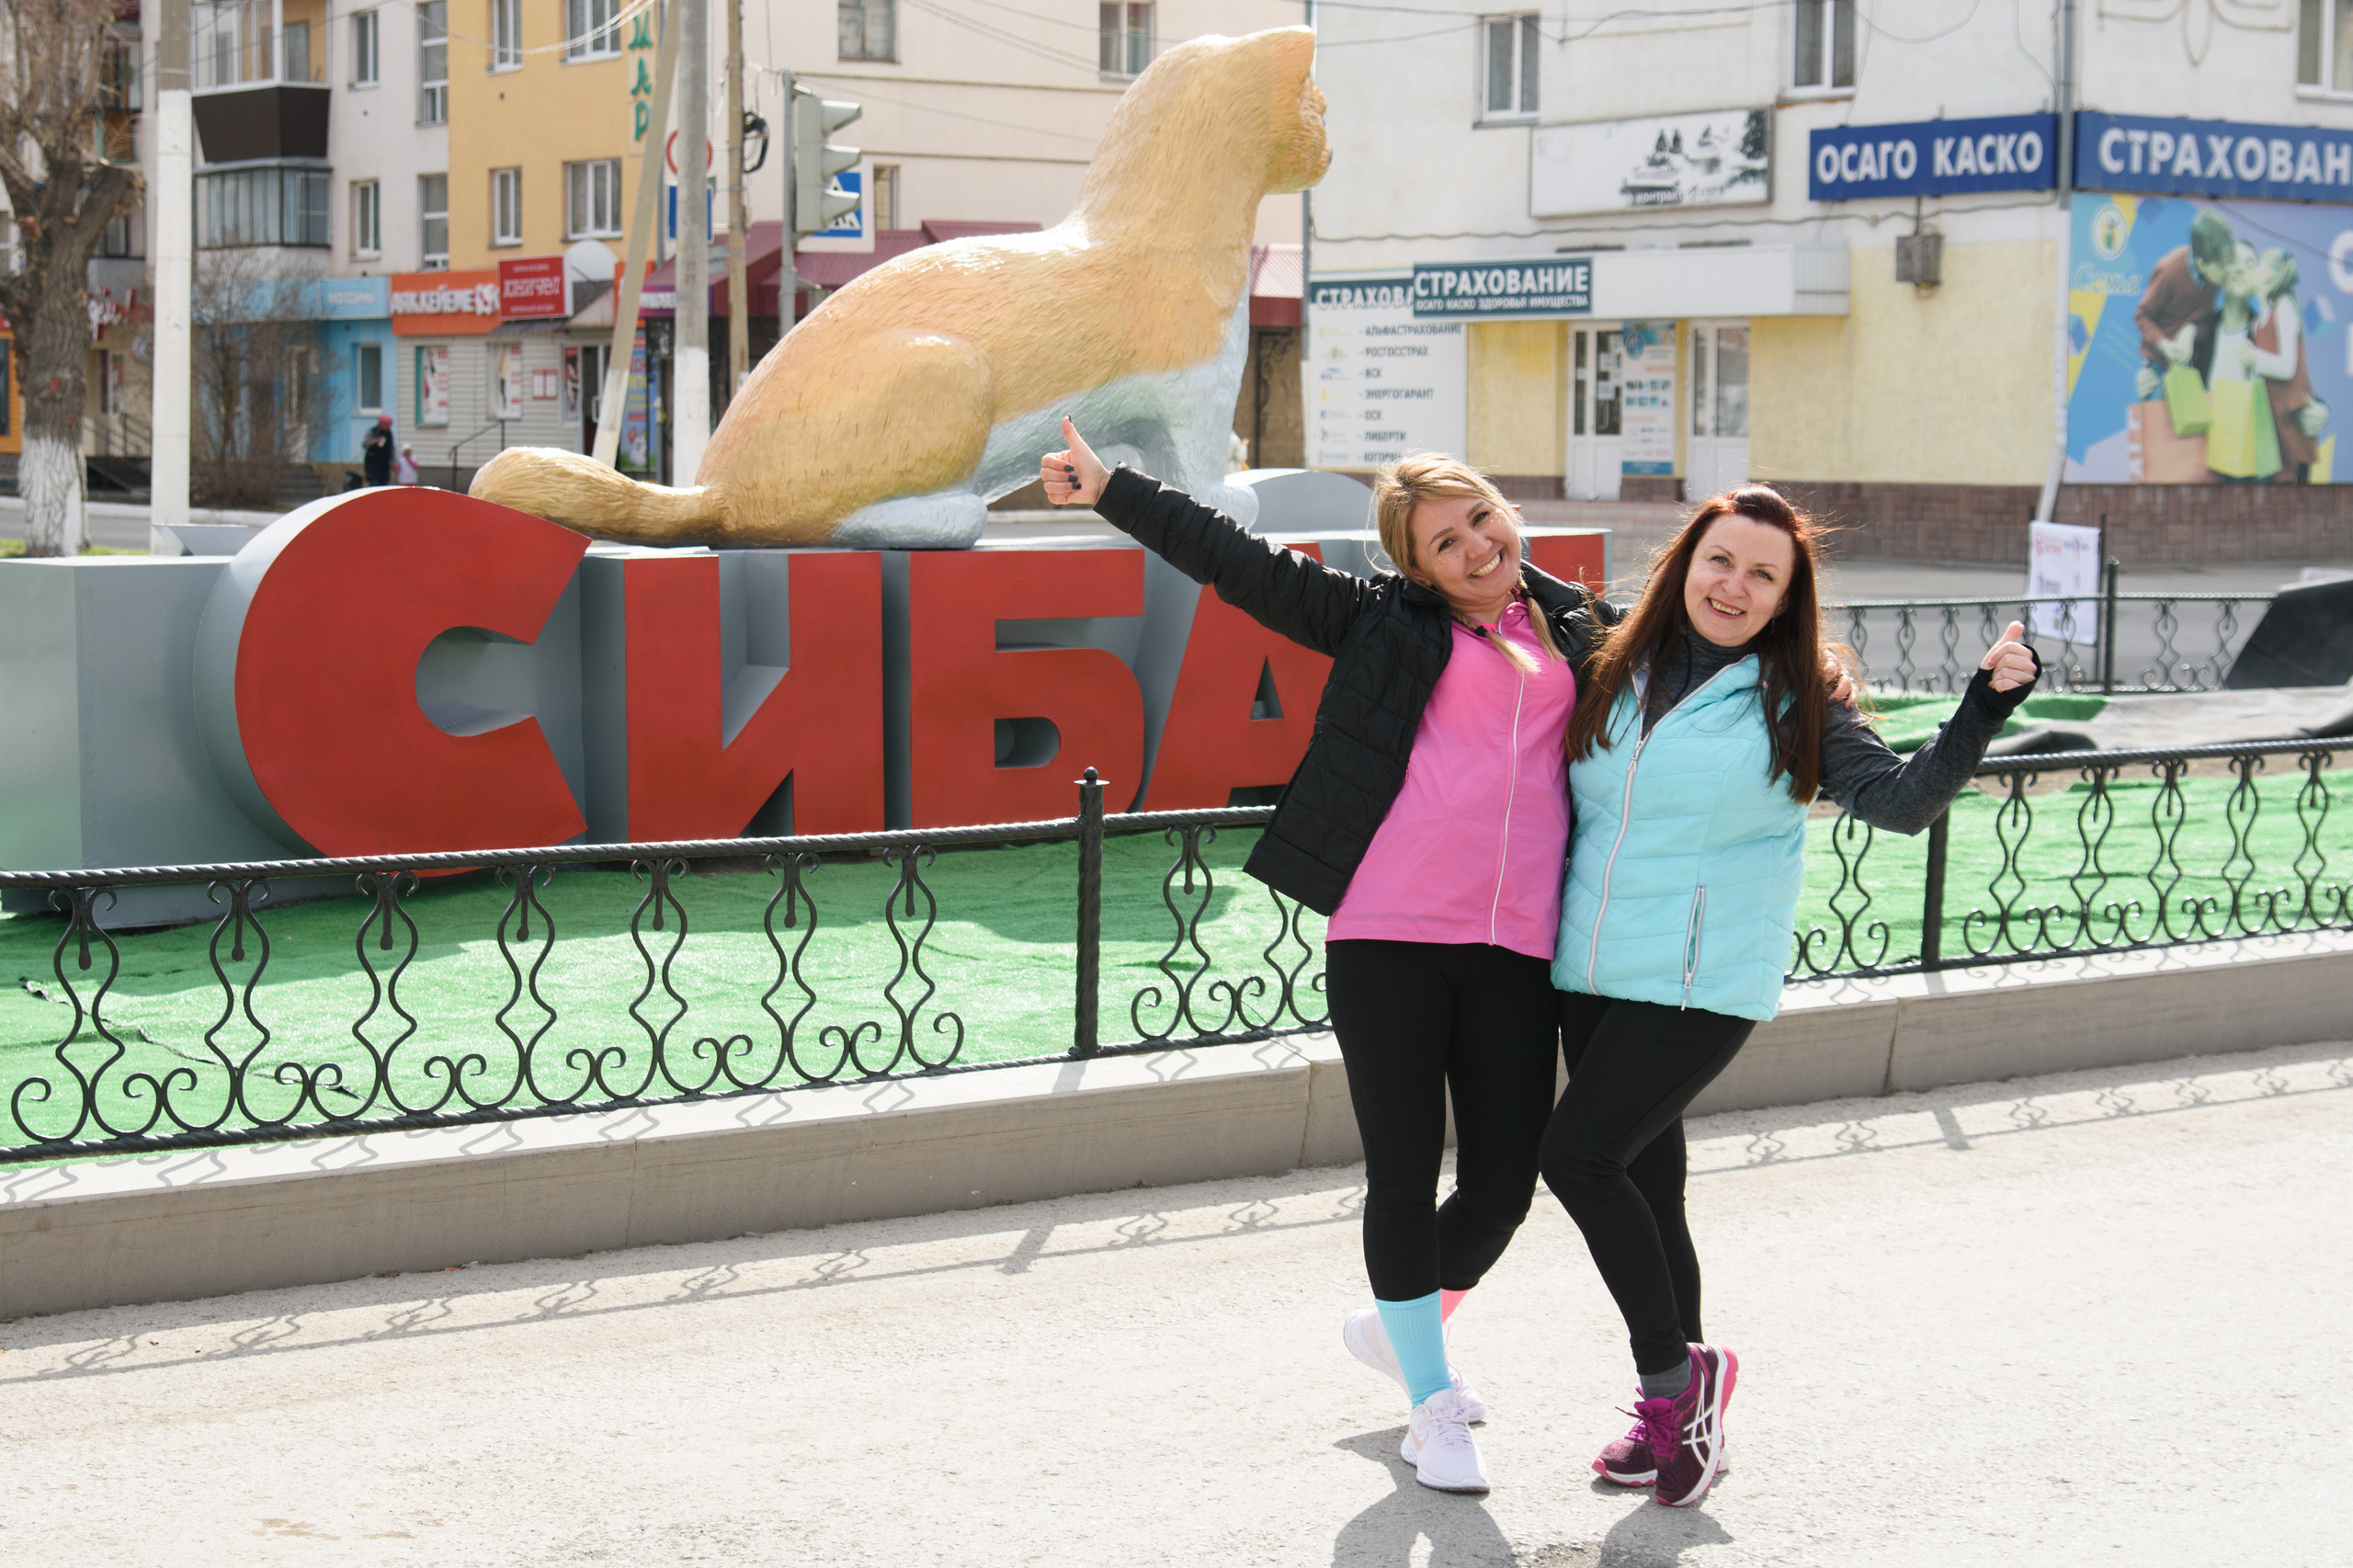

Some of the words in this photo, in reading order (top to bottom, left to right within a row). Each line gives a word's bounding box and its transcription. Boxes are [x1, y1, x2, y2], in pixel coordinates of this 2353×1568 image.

[1816, 140, 1917, 184] ОСАГО
[1933, 131, 2043, 177] КАСКО
[2098, 127, 2353, 186] СТРАХОВАН
[1414, 266, 1589, 297] СТРАХОВАНИЕ
[2075, 263, 2142, 295] Семья
[1415, 299, 1444, 311] ОСАГО
[1446, 297, 1476, 310] КАСКО
[1478, 297, 1527, 311] ЗДОРОВЬЯ
[1529, 295, 1588, 309] ИМУЩЕСТВА
[1365, 324, 1461, 336] АЛЬФАСТРАХОВАНИЕ
[1365, 346, 1429, 358] РОСГОССТРАХ
[1365, 369, 1382, 379] ВСК
[1365, 388, 1434, 400] ЭНЕРГОГАРАНТ
[1365, 411, 1382, 420] ОСК
[1364, 431, 1406, 441] ЛИБЕРТИ
[235, 485, 1605, 878] СИБА
